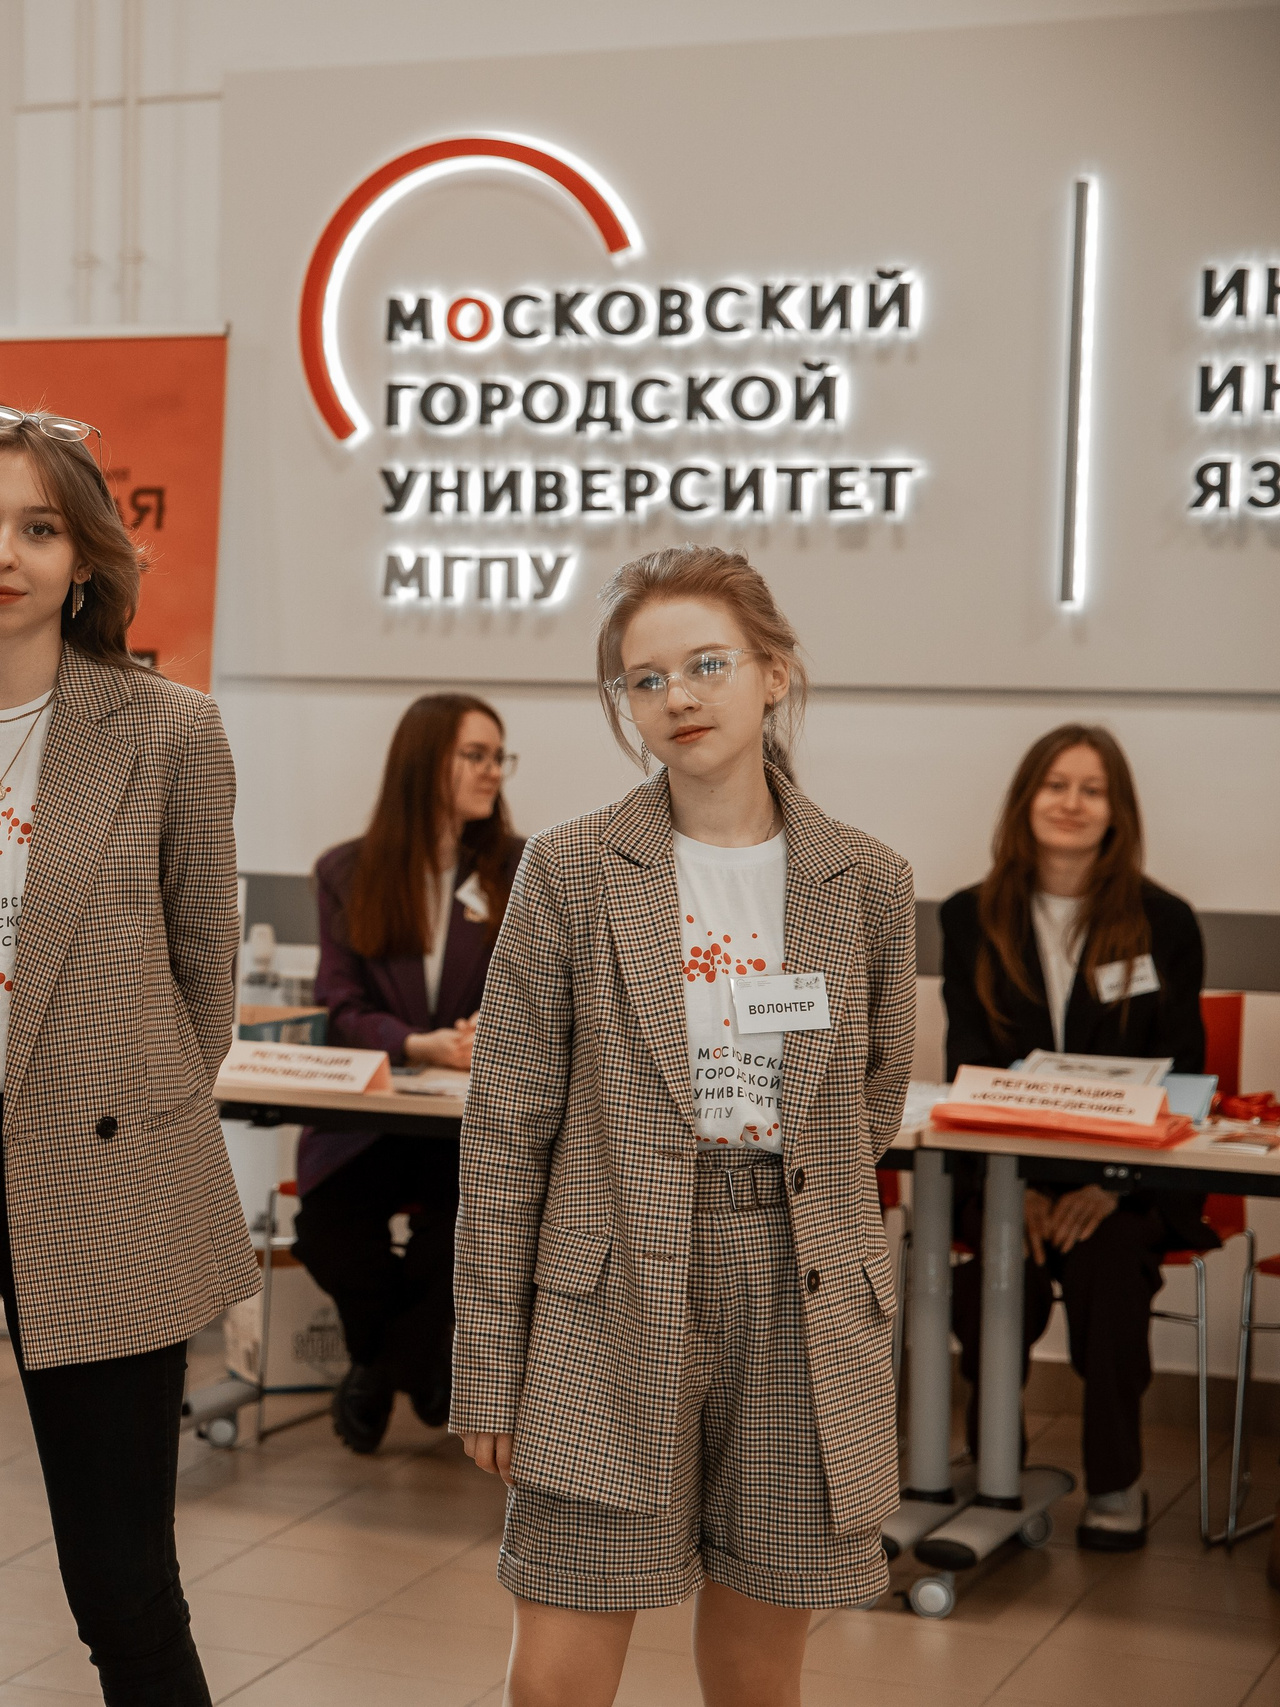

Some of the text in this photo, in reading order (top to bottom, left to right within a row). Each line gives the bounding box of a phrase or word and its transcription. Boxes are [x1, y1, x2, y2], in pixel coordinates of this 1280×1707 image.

[386, 269, 911, 343] МОСКОВСКИЙ
[385, 361, 837, 432] ГОРОДСКОЙ
[379, 466, 914, 514] УНИВЕРСИТЕТ
[382, 555, 572, 599] МГПУ
[749, 1001, 815, 1015] ВОЛОНТЕР
